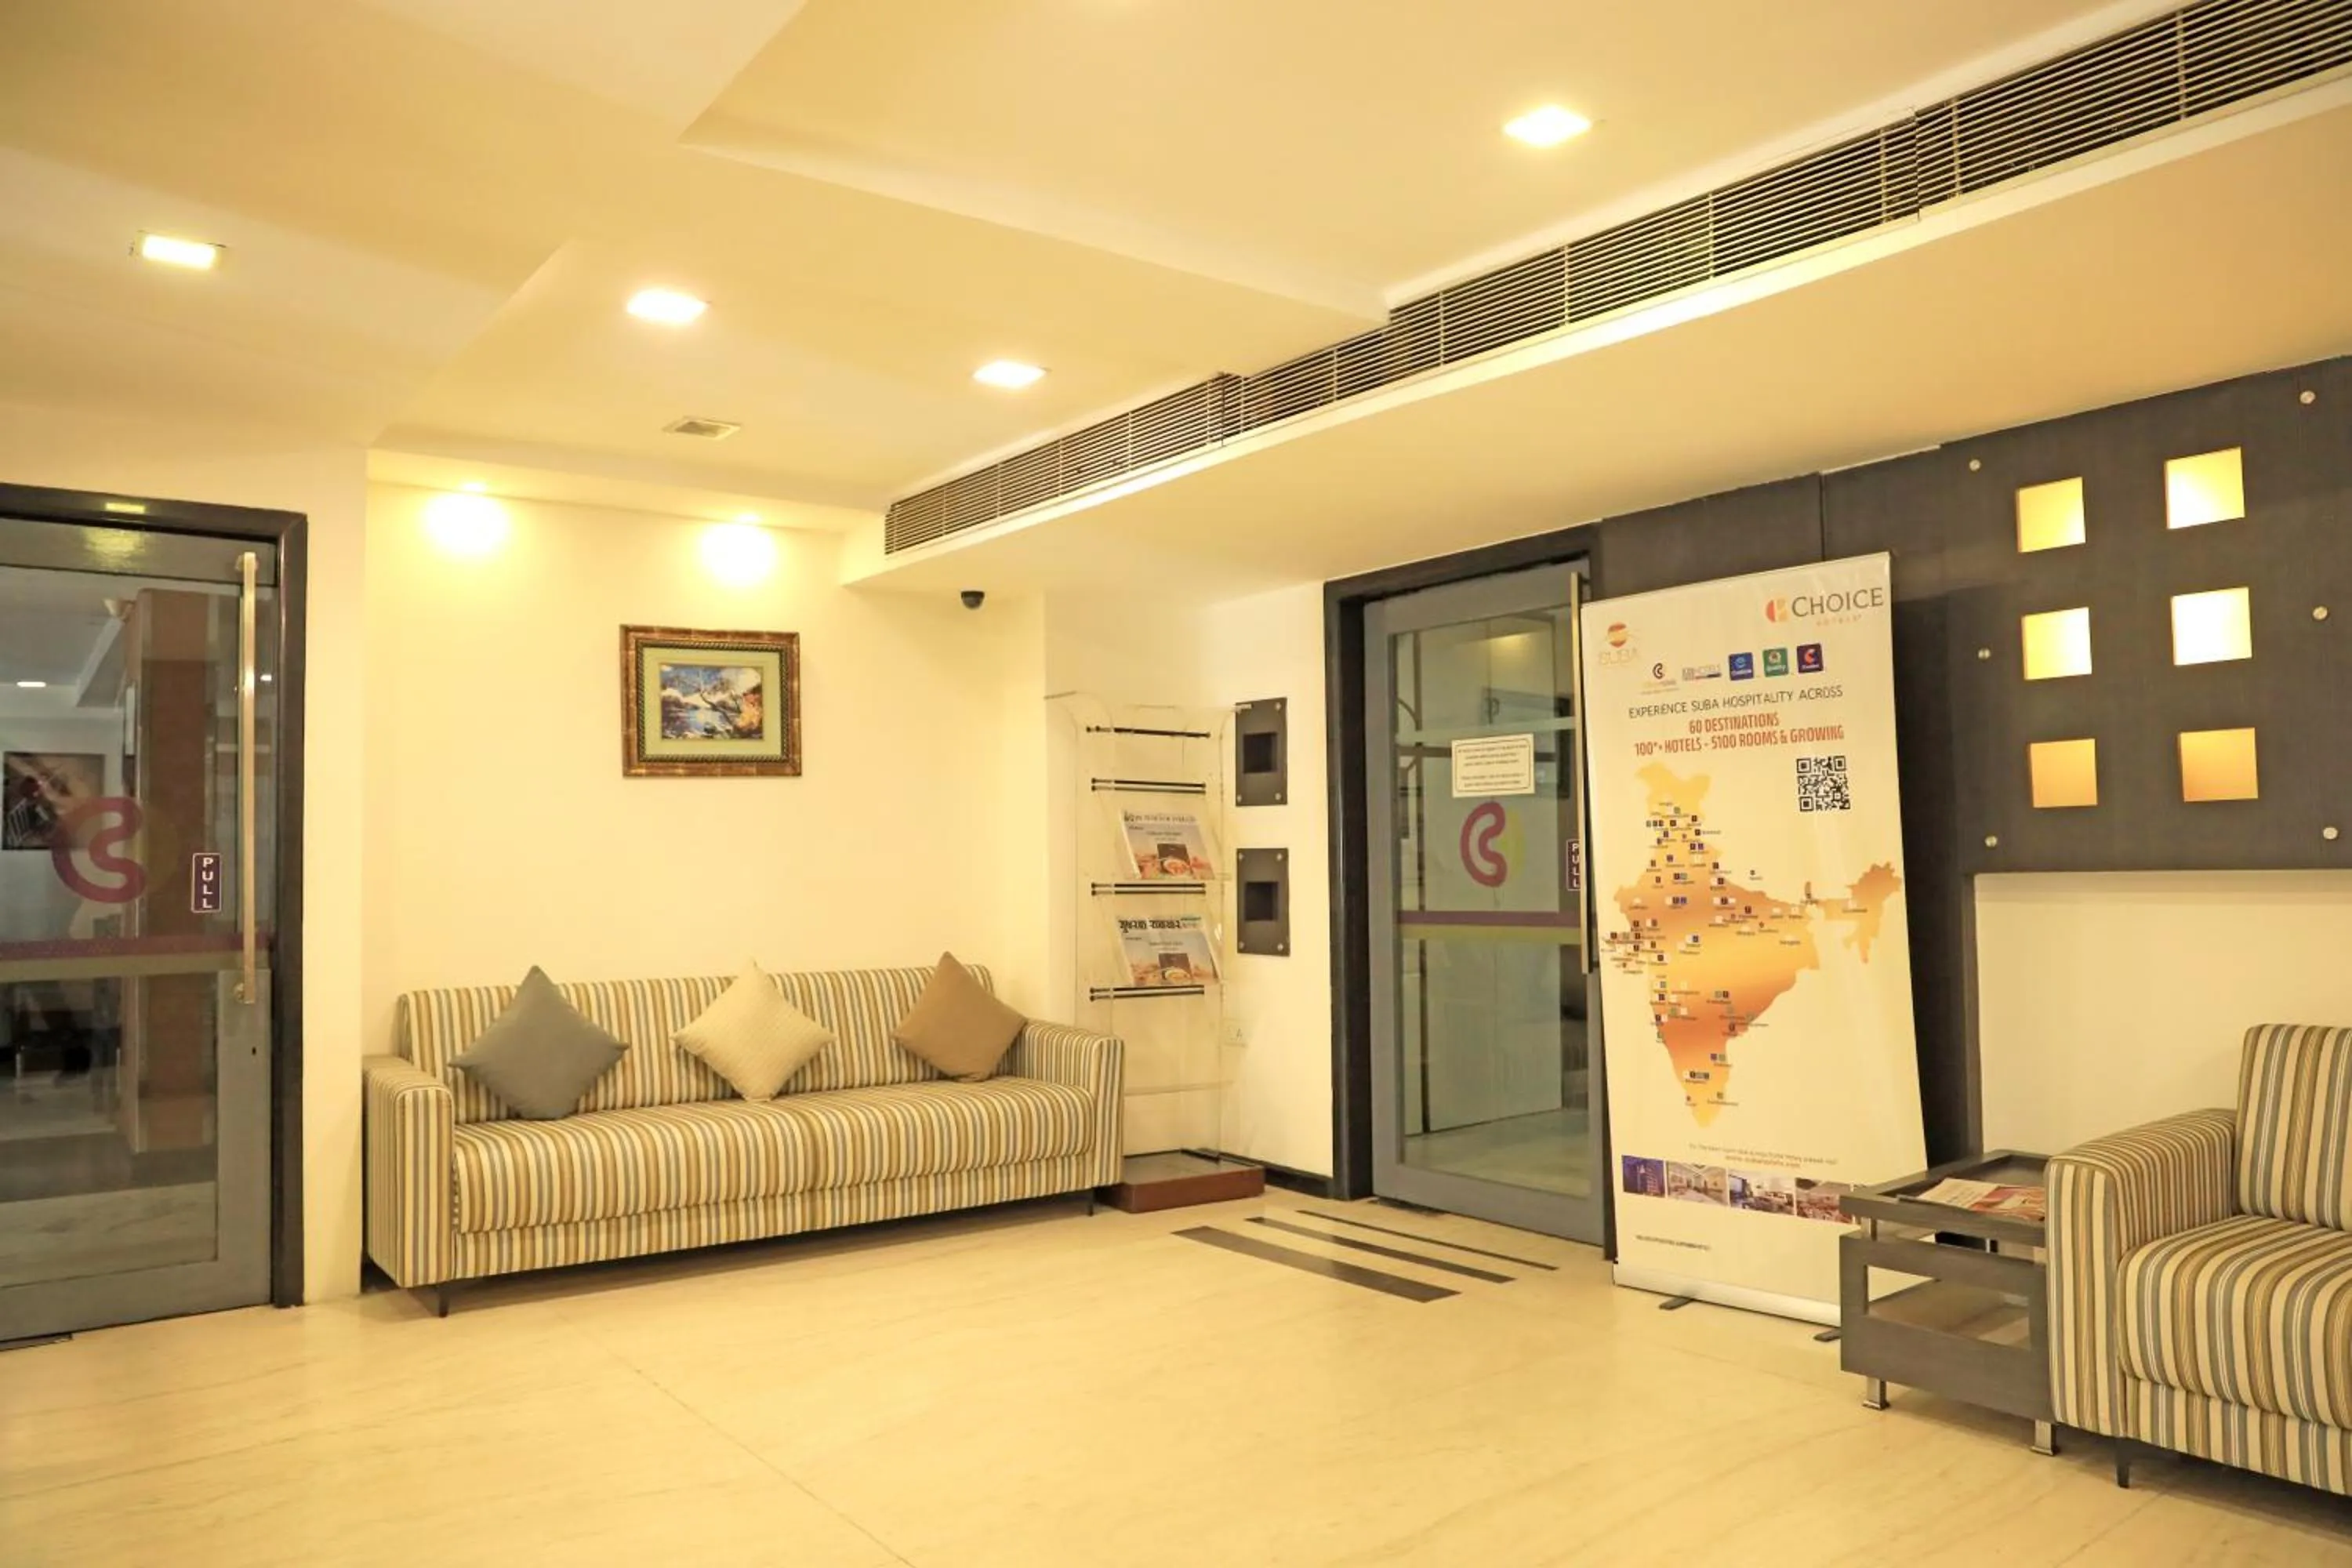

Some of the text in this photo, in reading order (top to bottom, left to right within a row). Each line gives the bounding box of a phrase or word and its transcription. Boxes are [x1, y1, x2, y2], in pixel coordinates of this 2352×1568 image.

[1791, 587, 1884, 617] CHOICE
[1691, 699, 1719, 712] SUBA
[1722, 691, 1793, 708] HOSPITALITY
[1798, 684, 1844, 700] ACROSS
[1689, 711, 1780, 734] 60 DESTINATIONS
[1664, 737, 1702, 753] HOTELS
[1739, 731, 1778, 747] ROOMS
[1791, 724, 1845, 744] GROWING
[201, 857, 213, 909] PULL
